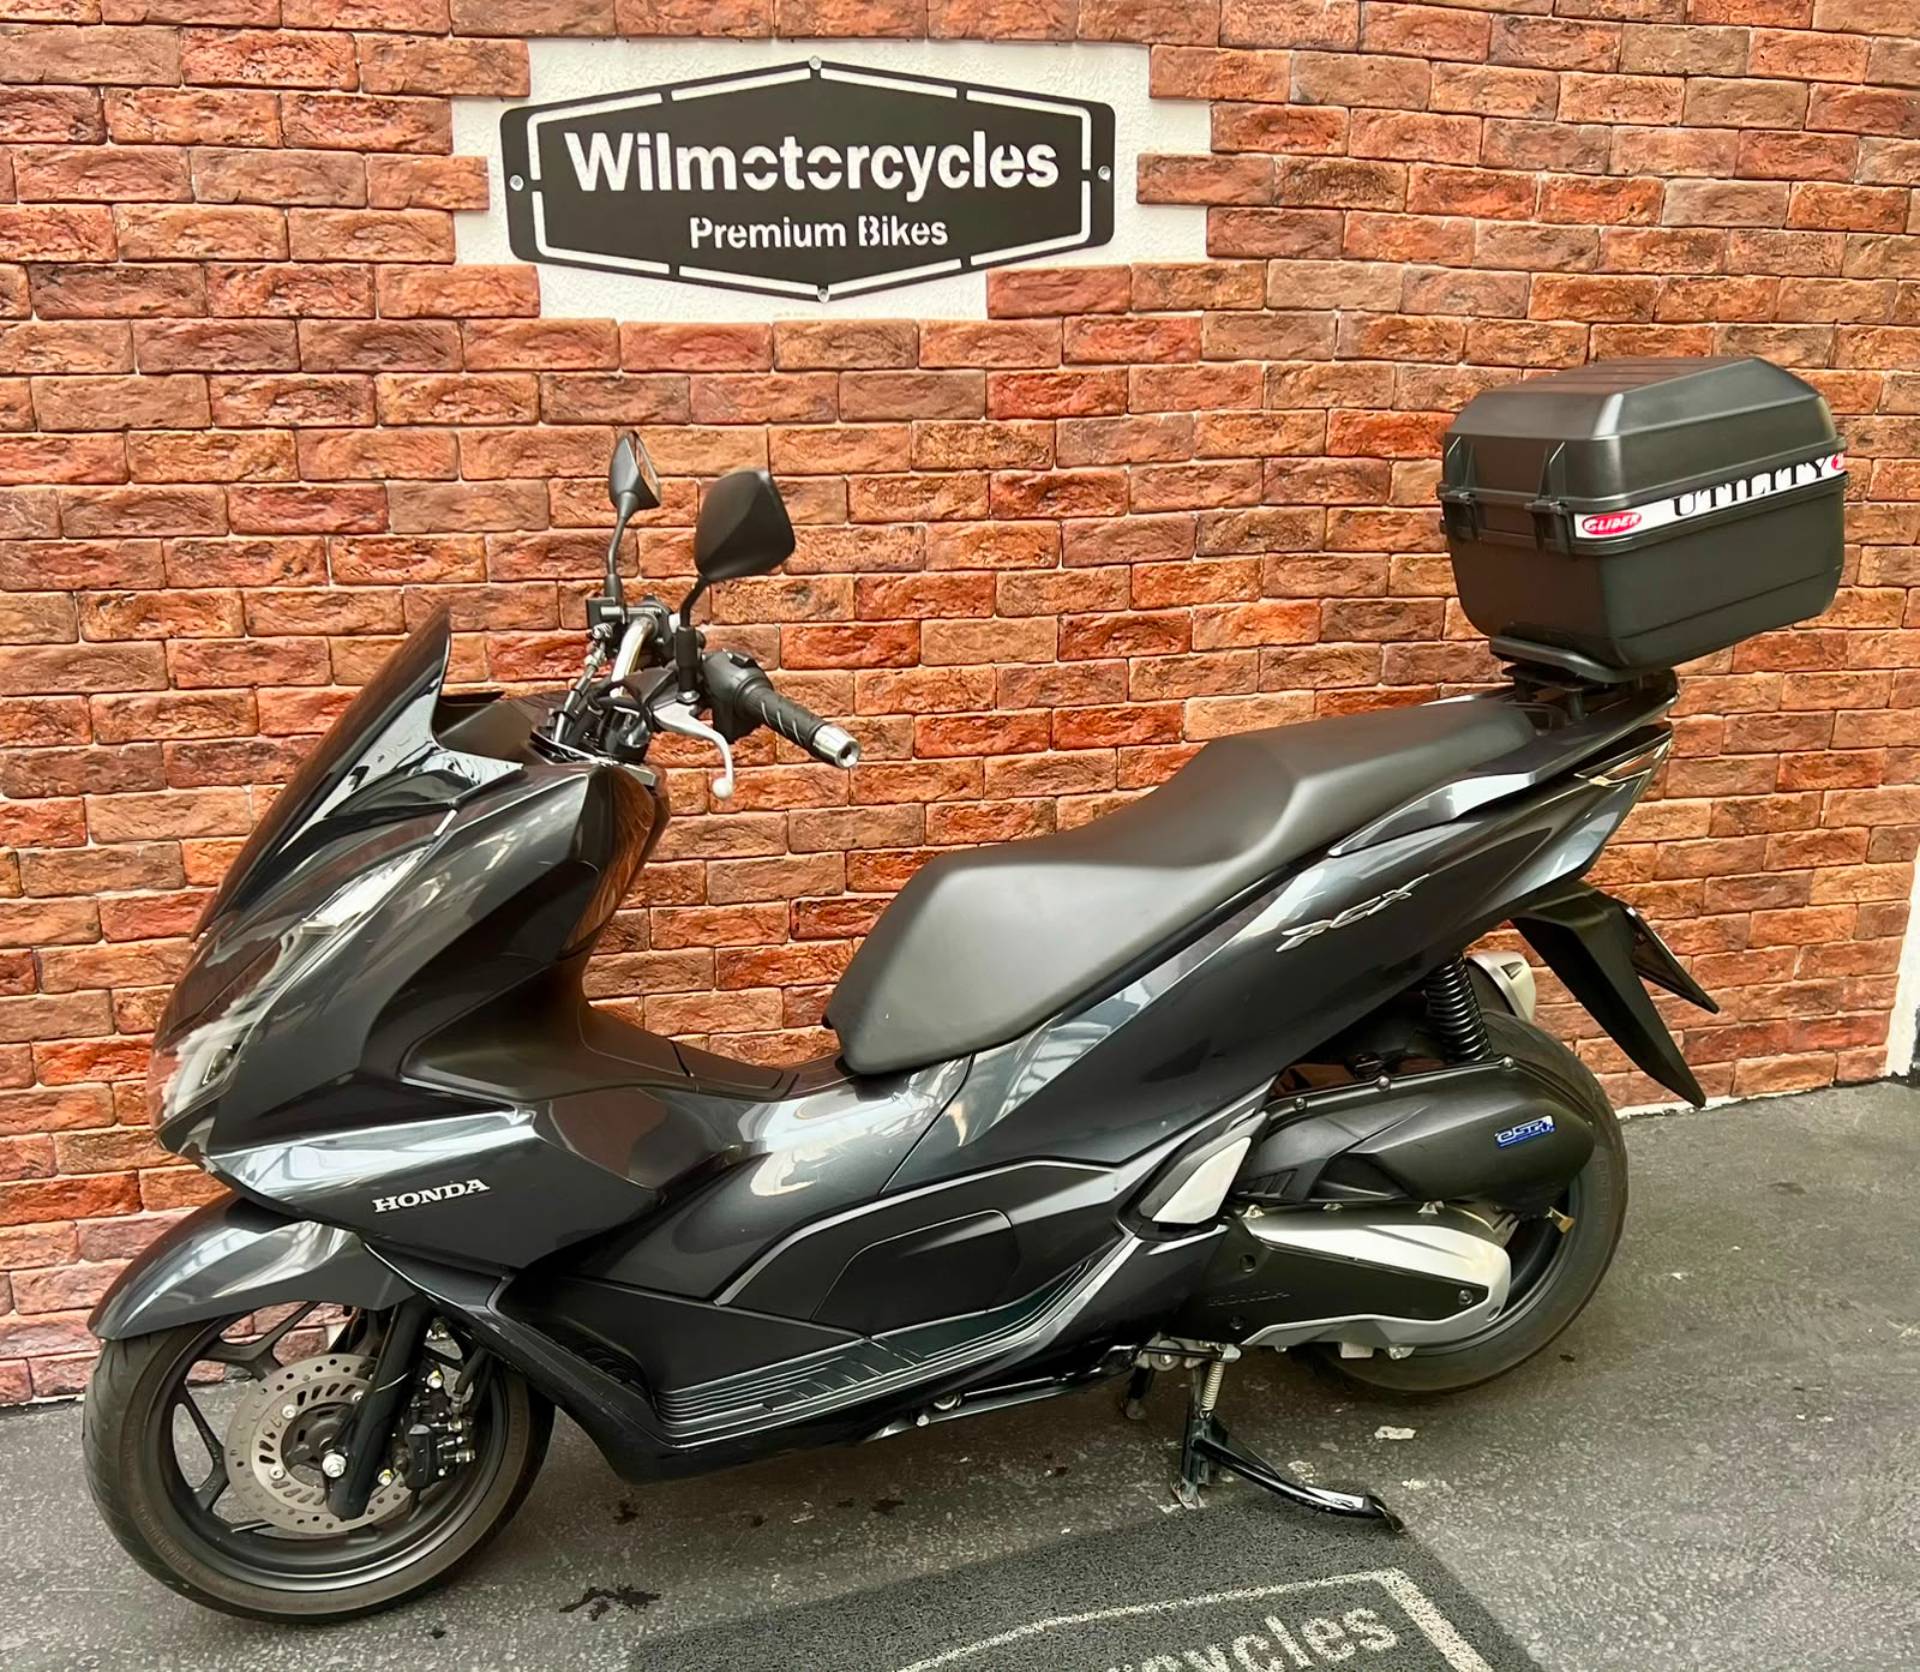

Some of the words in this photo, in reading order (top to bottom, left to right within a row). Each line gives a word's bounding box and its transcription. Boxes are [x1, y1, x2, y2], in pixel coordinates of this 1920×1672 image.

[565, 130, 1059, 202] Wilmotorcycles
[689, 215, 847, 249] Premium
[858, 213, 949, 247] Bikes
[1674, 458, 1828, 517] UTILITY
[372, 1178, 491, 1213] HONDA
